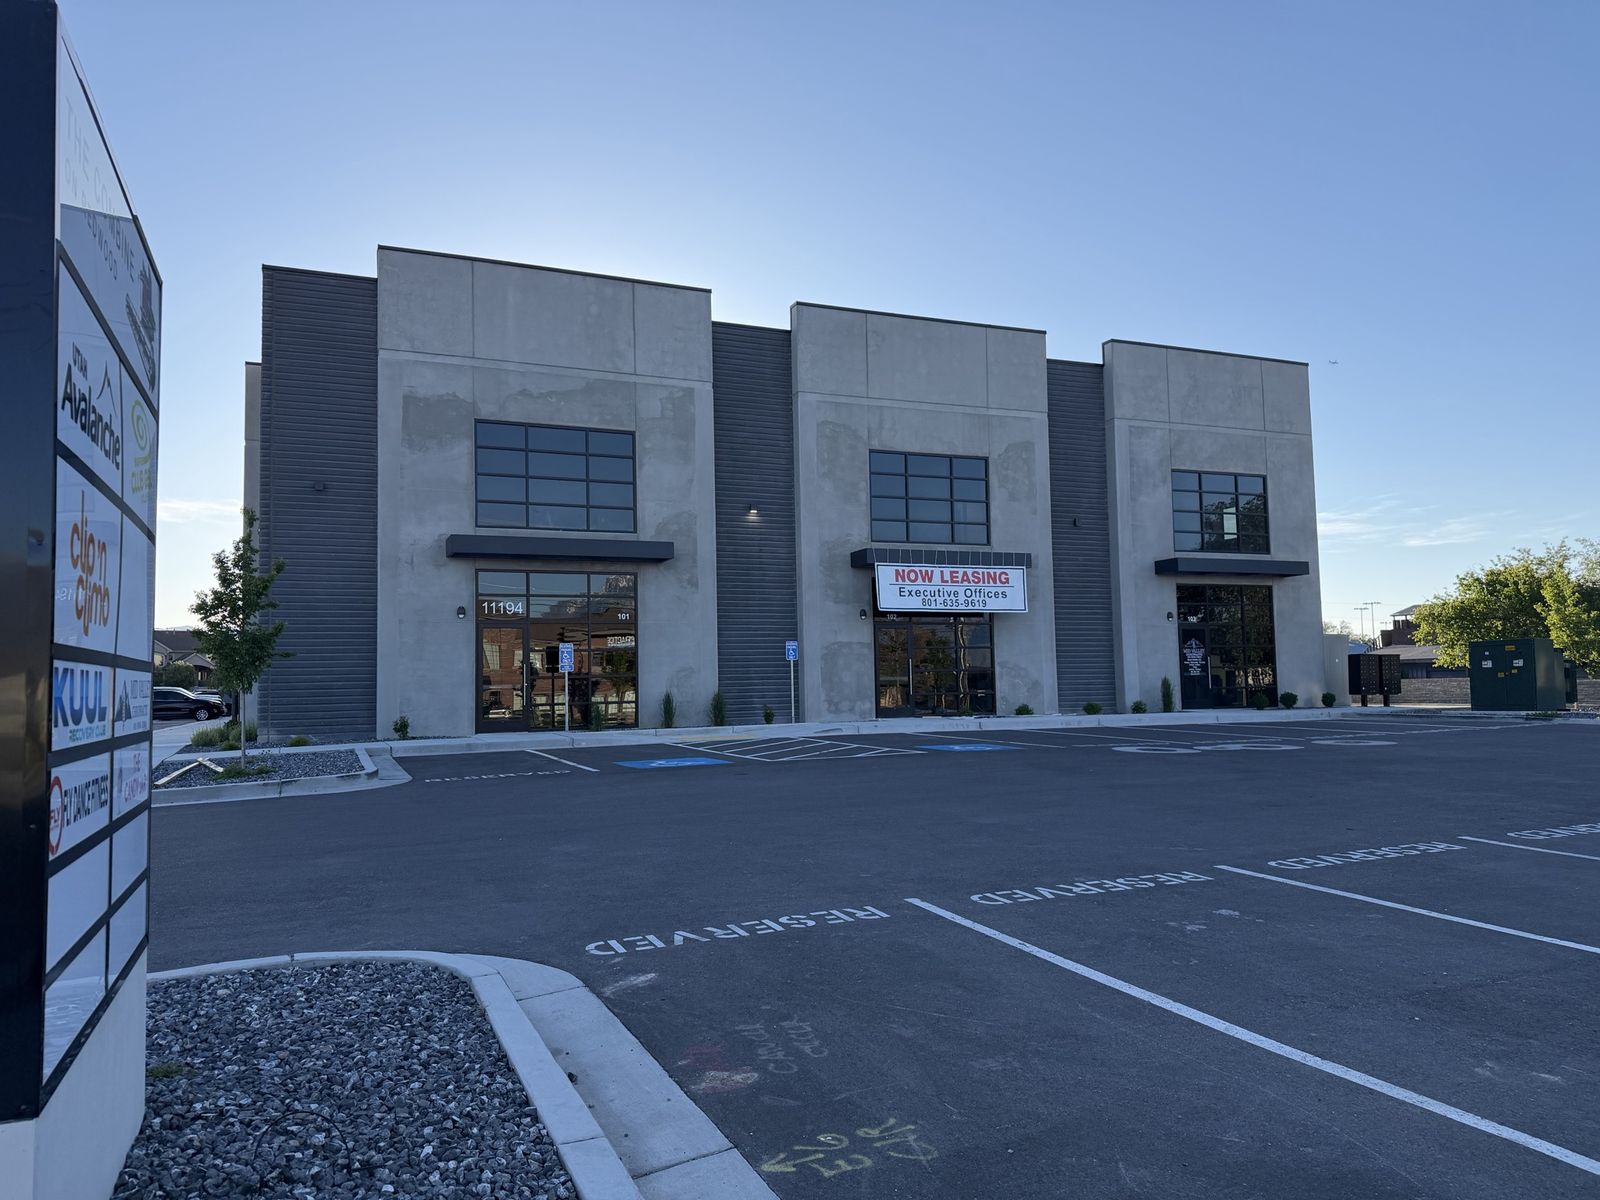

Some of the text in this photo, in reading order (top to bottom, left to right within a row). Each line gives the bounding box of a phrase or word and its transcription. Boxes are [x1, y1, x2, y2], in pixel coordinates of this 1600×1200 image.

[65, 95, 90, 183] THE
[65, 157, 78, 201] ON
[72, 341, 88, 381] UTAH
[61, 362, 120, 471] Avalanche
[895, 568, 1010, 585] NOW LEASING
[898, 587, 1008, 599] Executive Offices
[482, 601, 523, 615] 11194
[921, 598, 987, 608] 801-635-9619
[54, 667, 108, 728] KUUL
[63, 790, 73, 828] FLY
[73, 780, 91, 823] DANCE
[1267, 841, 1467, 871] RESERVED
[970, 870, 1214, 906] RESERVED
[584, 905, 891, 956] RESERVED
